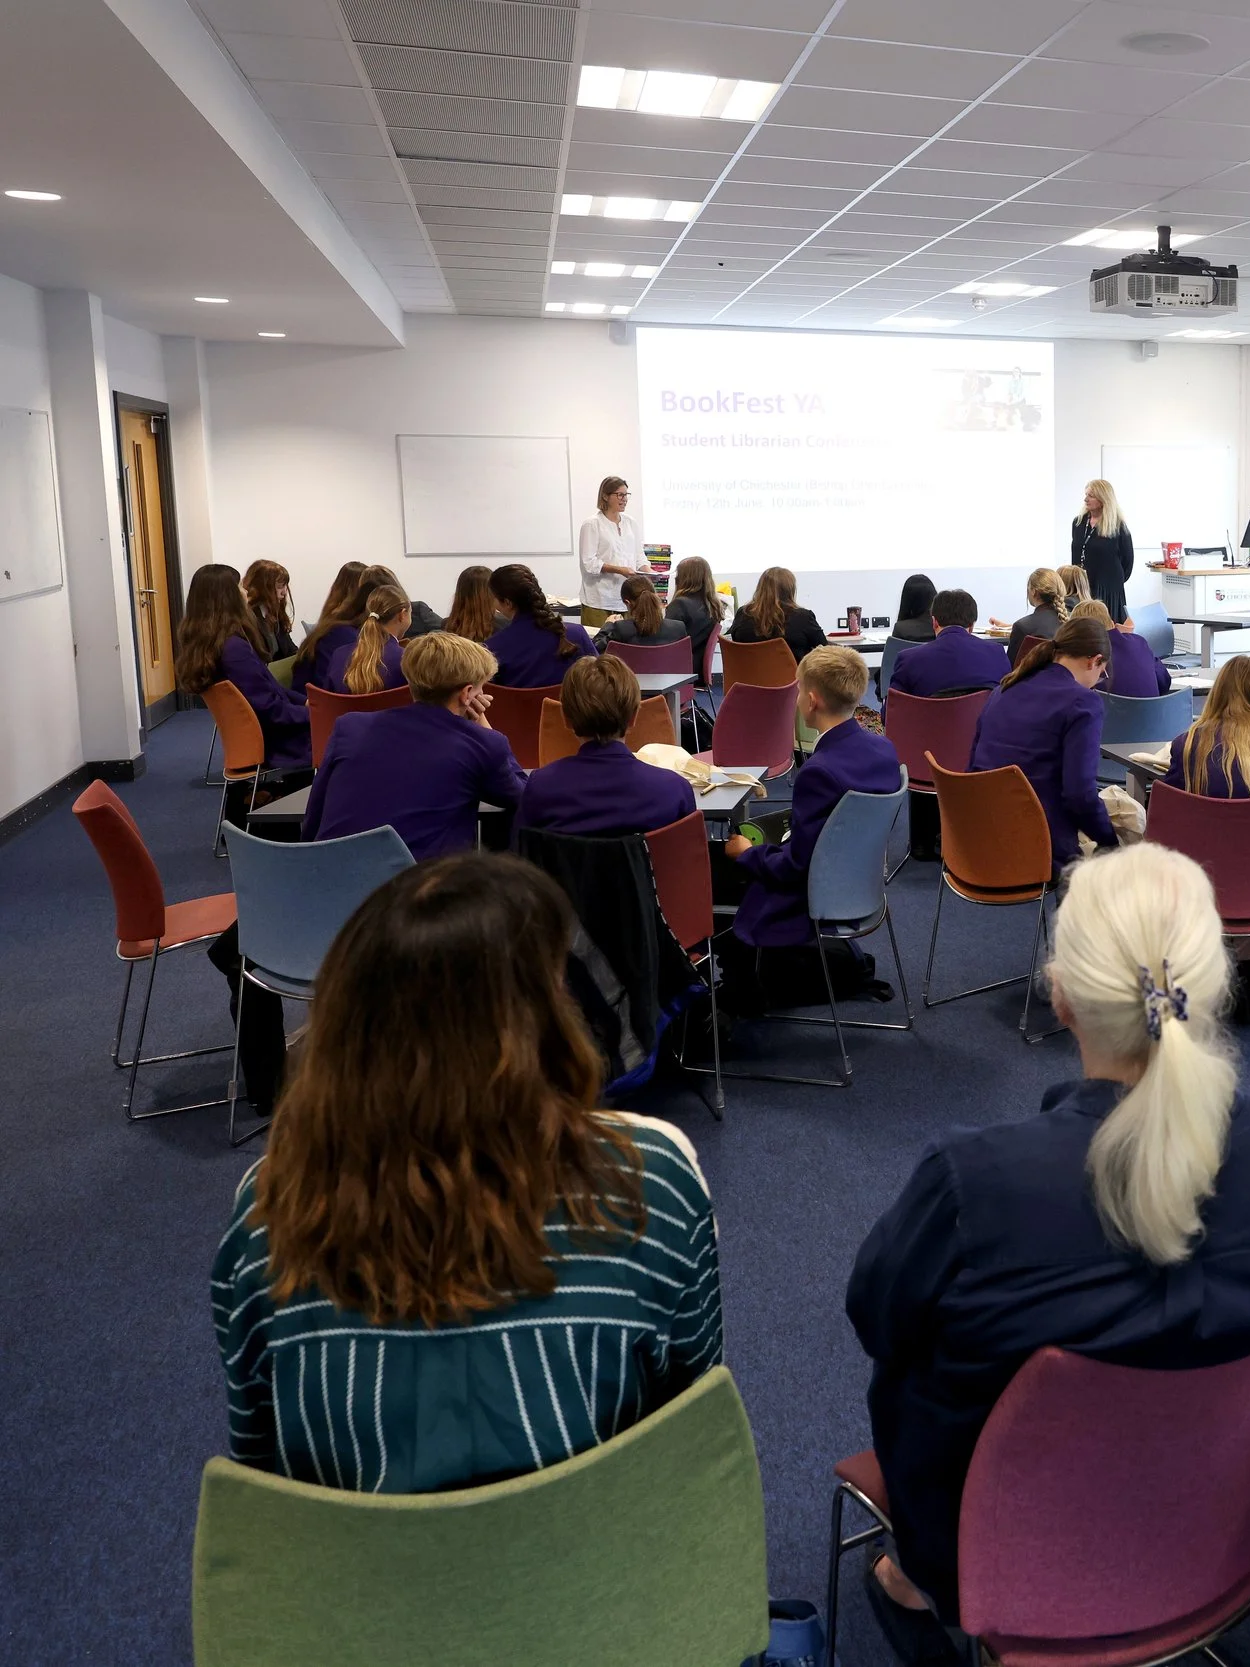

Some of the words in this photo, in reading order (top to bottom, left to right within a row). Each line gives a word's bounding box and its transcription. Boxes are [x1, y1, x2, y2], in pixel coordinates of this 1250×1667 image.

[660, 389, 785, 414] BookFest
[792, 392, 826, 414] YA
[661, 433, 727, 448] Student
[731, 433, 801, 448] Librarian
[662, 478, 721, 493] University
